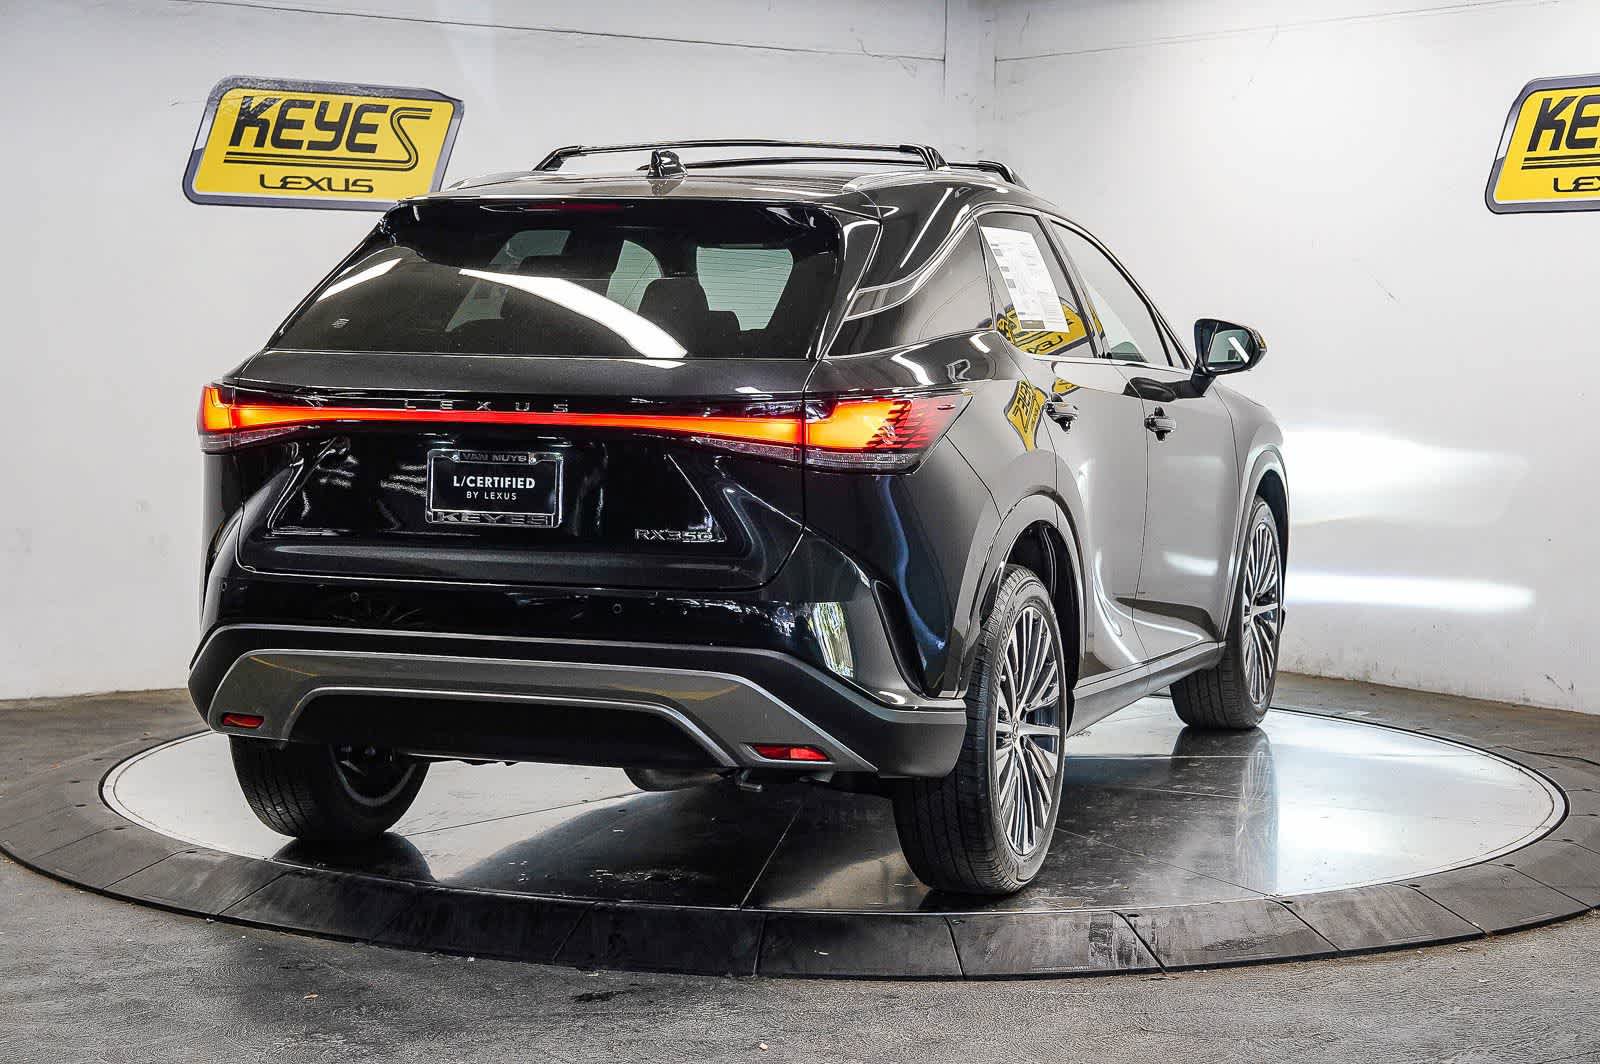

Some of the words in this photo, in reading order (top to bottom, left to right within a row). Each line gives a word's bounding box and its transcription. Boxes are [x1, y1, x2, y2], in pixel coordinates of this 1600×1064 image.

[226, 95, 432, 171] KEYES
[259, 174, 374, 193] LEXUS
[1553, 176, 1600, 192] LE
[404, 399, 569, 412] LEXUS
[462, 452, 488, 461] VAN
[453, 475, 536, 489] L/CERTIFIED
[466, 491, 479, 499] BY
[484, 491, 517, 500] LEXUS
[437, 511, 547, 525] KEYES
